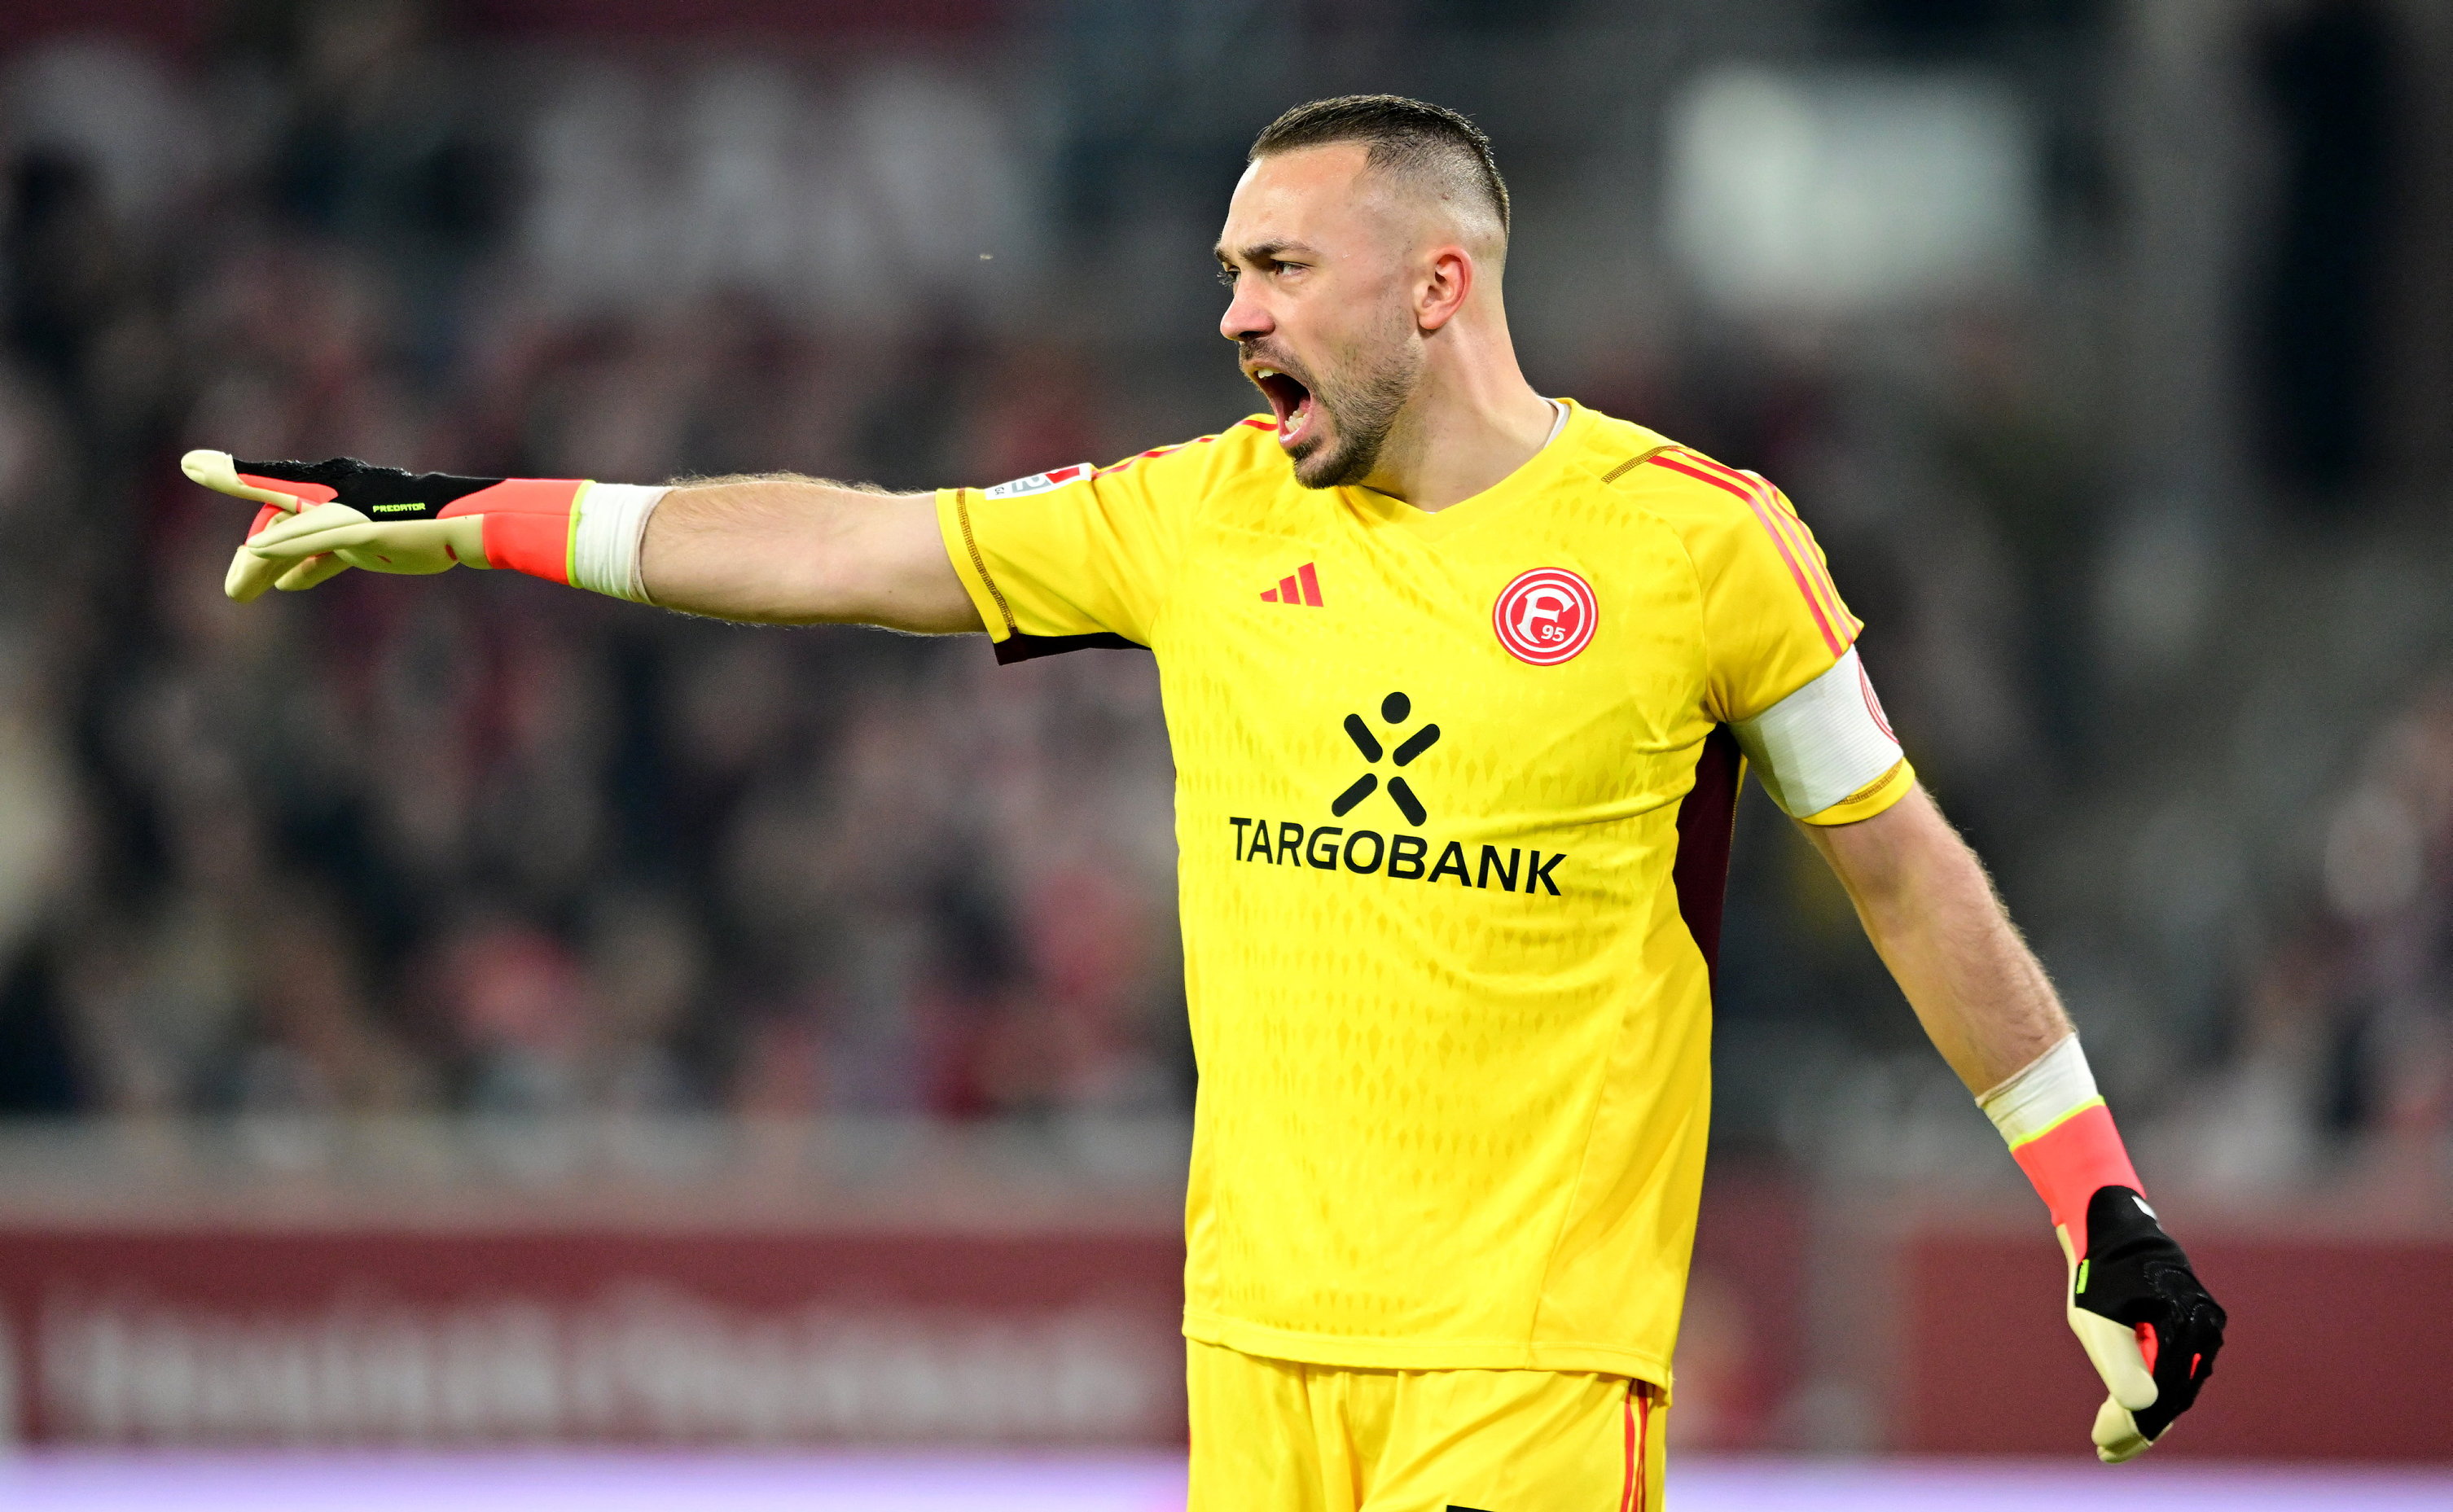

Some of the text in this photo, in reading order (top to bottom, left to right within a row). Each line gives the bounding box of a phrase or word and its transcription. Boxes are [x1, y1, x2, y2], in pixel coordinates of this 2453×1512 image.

[372, 502, 426, 513] PREDATOR
[1541, 625, 1566, 642] 95
[1229, 816, 1567, 896] TARGOBANK
